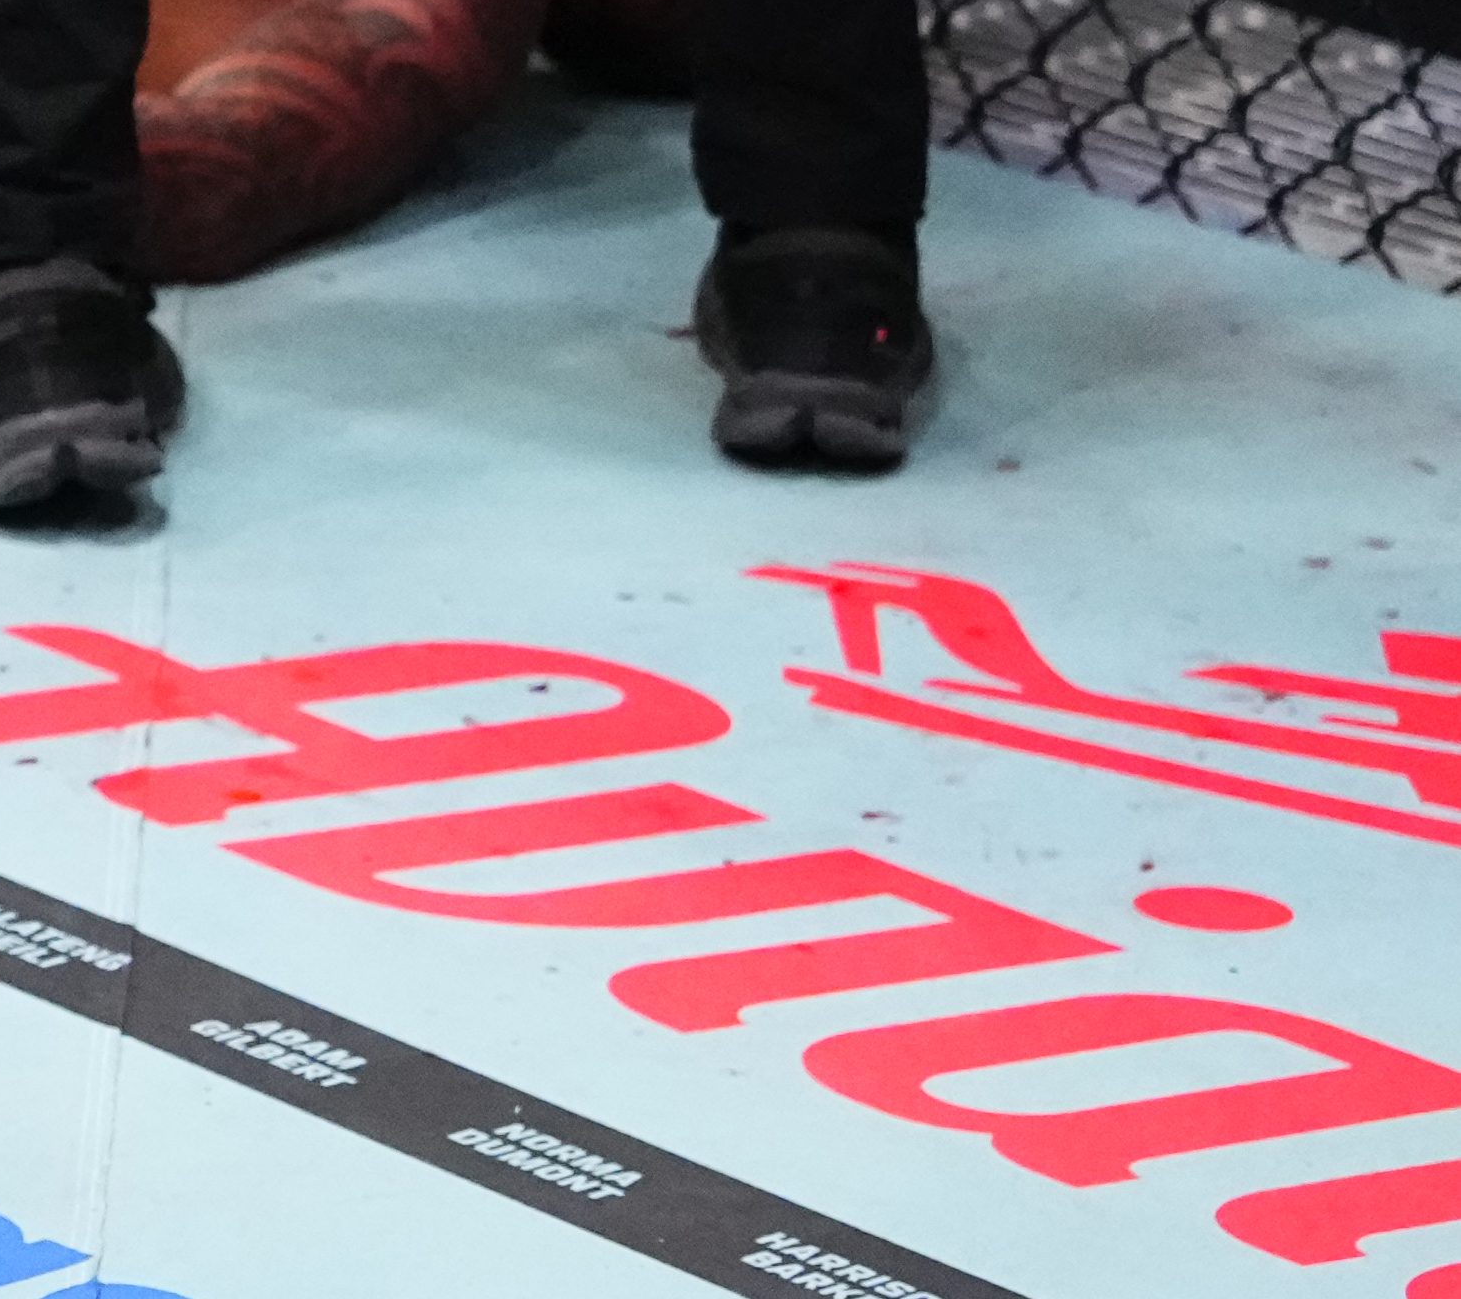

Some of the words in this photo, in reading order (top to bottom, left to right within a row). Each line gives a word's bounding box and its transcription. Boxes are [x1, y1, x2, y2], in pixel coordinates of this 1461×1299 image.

[189, 1019, 359, 1088] GILBERT
[243, 1019, 367, 1072] ADAM
[447, 1127, 626, 1200] DUMONT
[493, 1122, 643, 1188] NORMA
